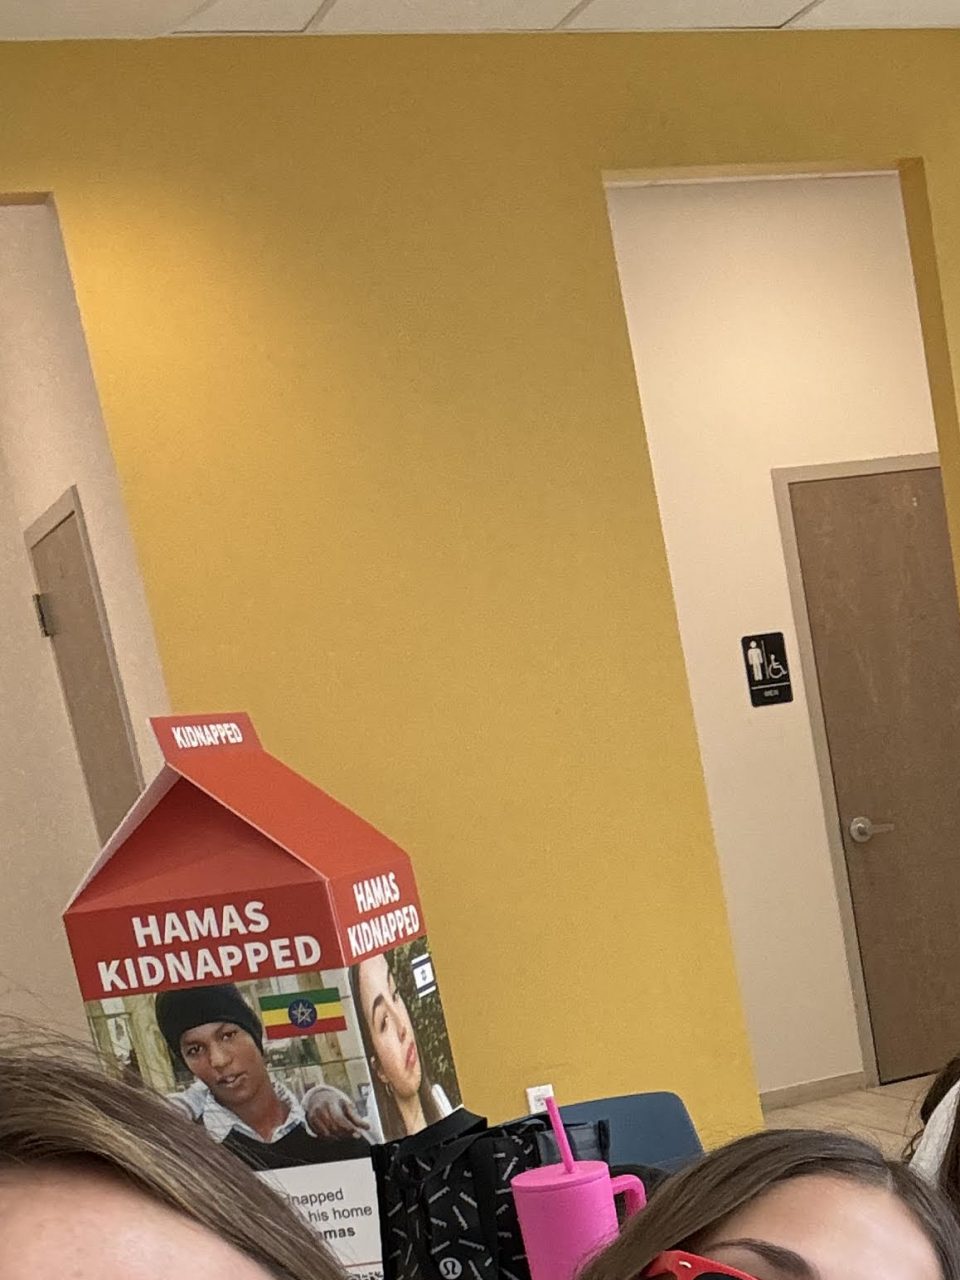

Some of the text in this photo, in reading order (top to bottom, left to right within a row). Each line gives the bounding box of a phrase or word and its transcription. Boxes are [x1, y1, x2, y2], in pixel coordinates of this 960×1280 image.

[171, 721, 244, 749] KIDNAPPED
[352, 871, 400, 913] HAMAS
[132, 900, 270, 948] HAMAS
[348, 904, 420, 958] KIDNAPPED
[97, 935, 322, 993] KIDNAPPED
[289, 1187, 345, 1206] napped
[308, 1205, 373, 1223] his home
